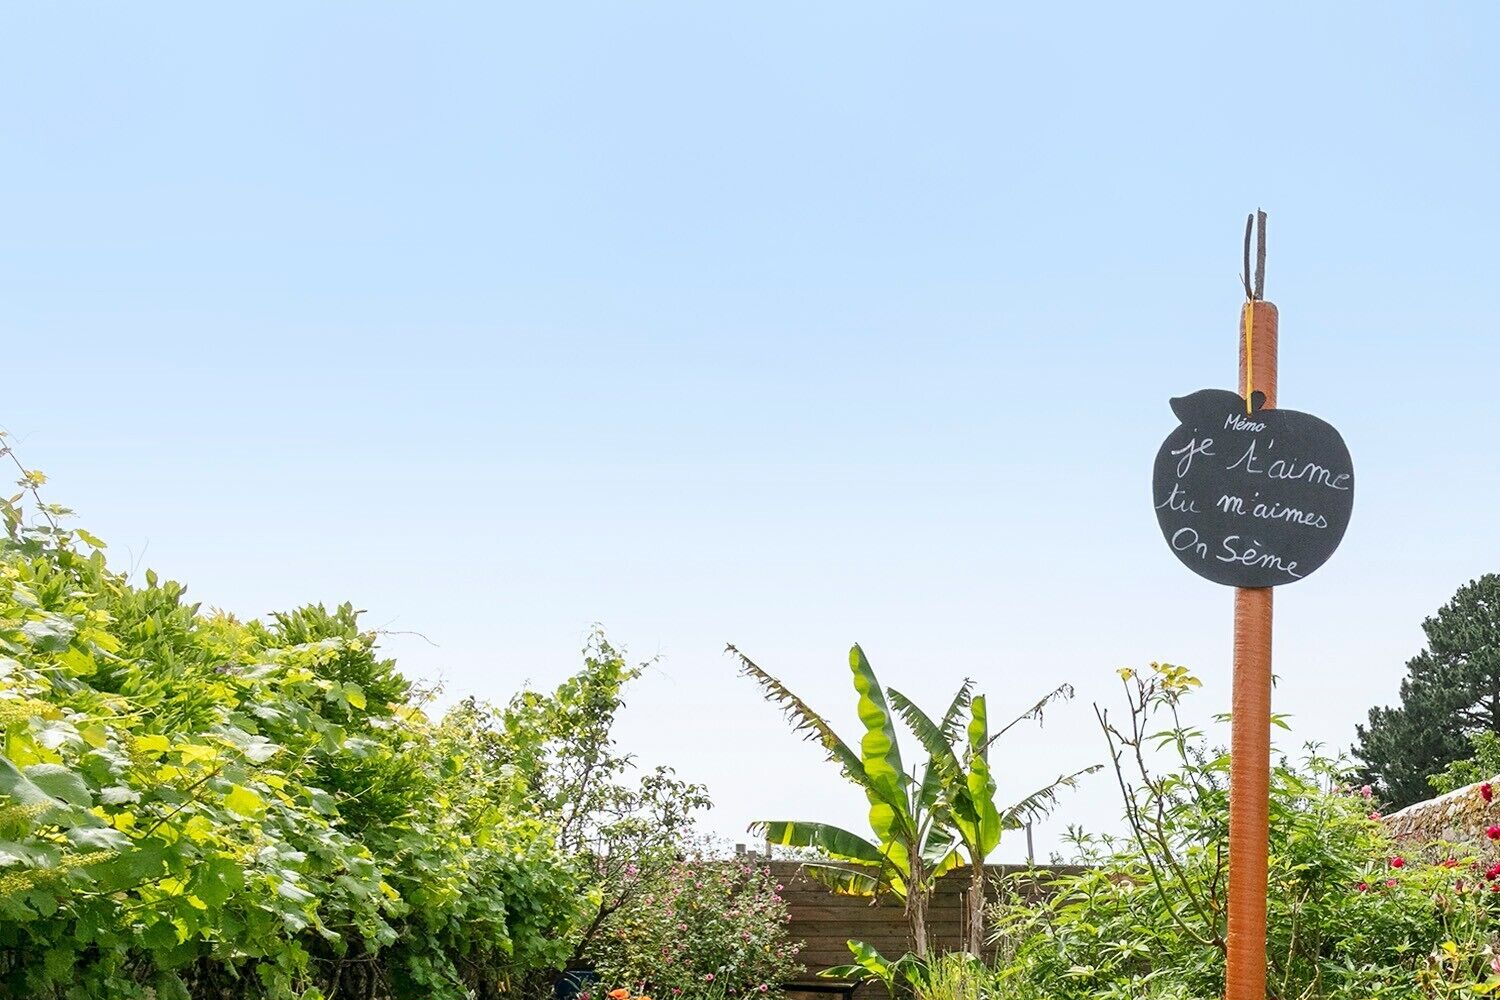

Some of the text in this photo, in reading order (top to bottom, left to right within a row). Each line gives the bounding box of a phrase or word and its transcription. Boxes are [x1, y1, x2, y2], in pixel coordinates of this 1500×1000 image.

[1224, 413, 1266, 433] Mémo
[1171, 428, 1350, 490] je t'aime
[1155, 483, 1328, 529] tu m'aimes
[1171, 527, 1303, 578] On Sème
